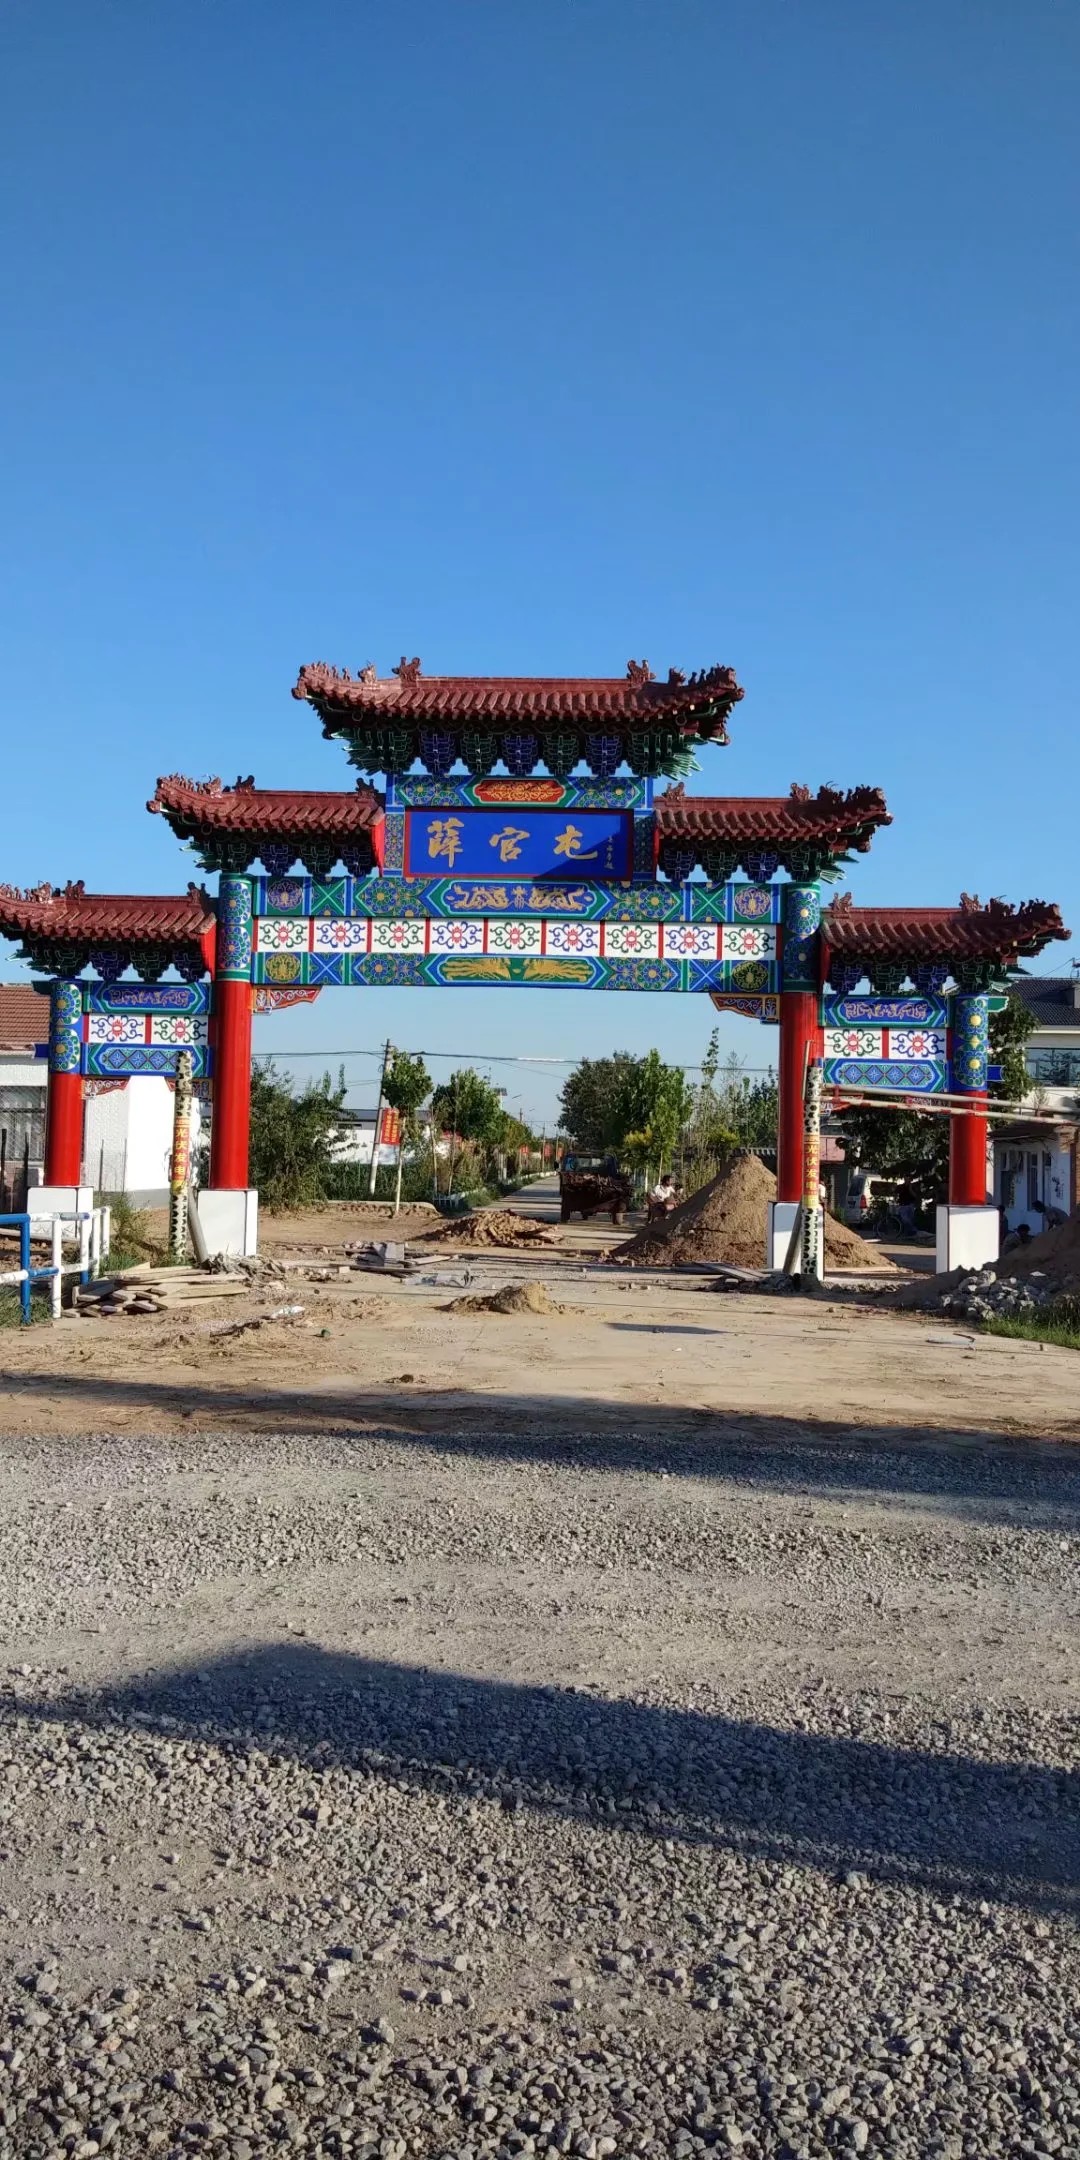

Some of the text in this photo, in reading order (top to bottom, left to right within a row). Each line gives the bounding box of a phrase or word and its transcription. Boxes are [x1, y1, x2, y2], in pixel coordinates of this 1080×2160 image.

[174, 1128, 188, 1176] 光伏发电
[805, 1144, 818, 1191] 光伏发电
